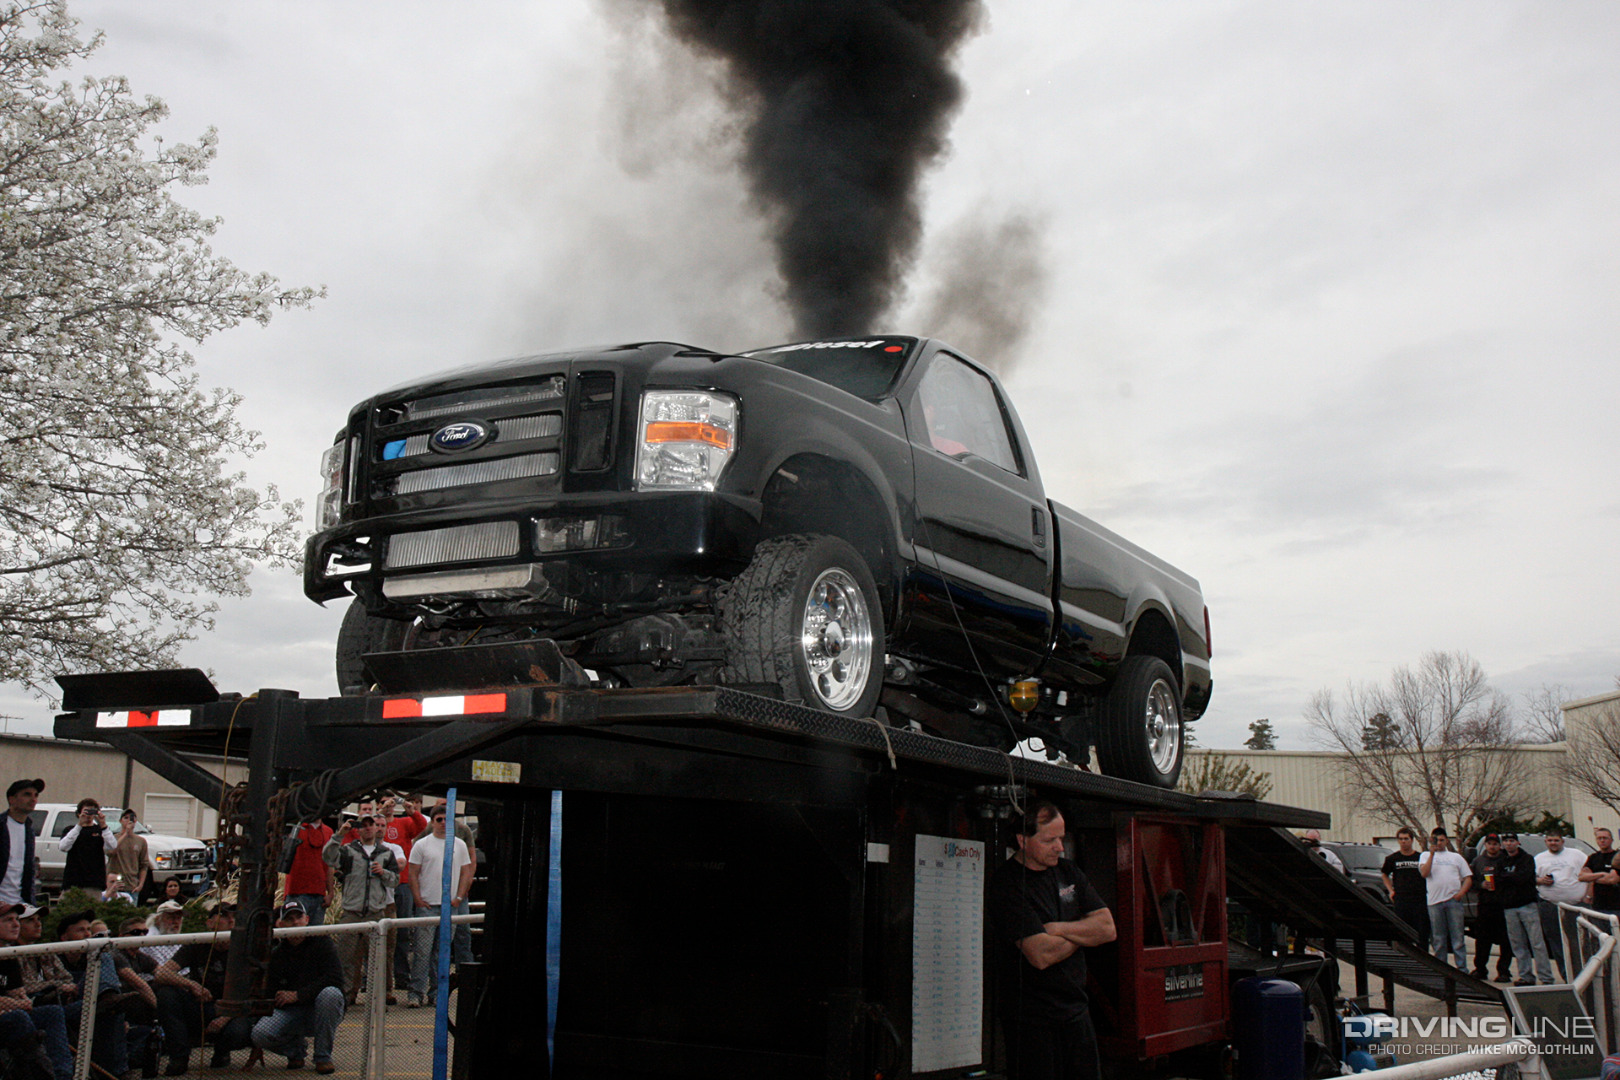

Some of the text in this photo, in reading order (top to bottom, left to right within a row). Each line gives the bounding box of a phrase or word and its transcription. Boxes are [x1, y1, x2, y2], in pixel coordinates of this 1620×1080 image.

[441, 426, 470, 442] Ford
[954, 846, 968, 858] Cash
[969, 847, 980, 861] Only
